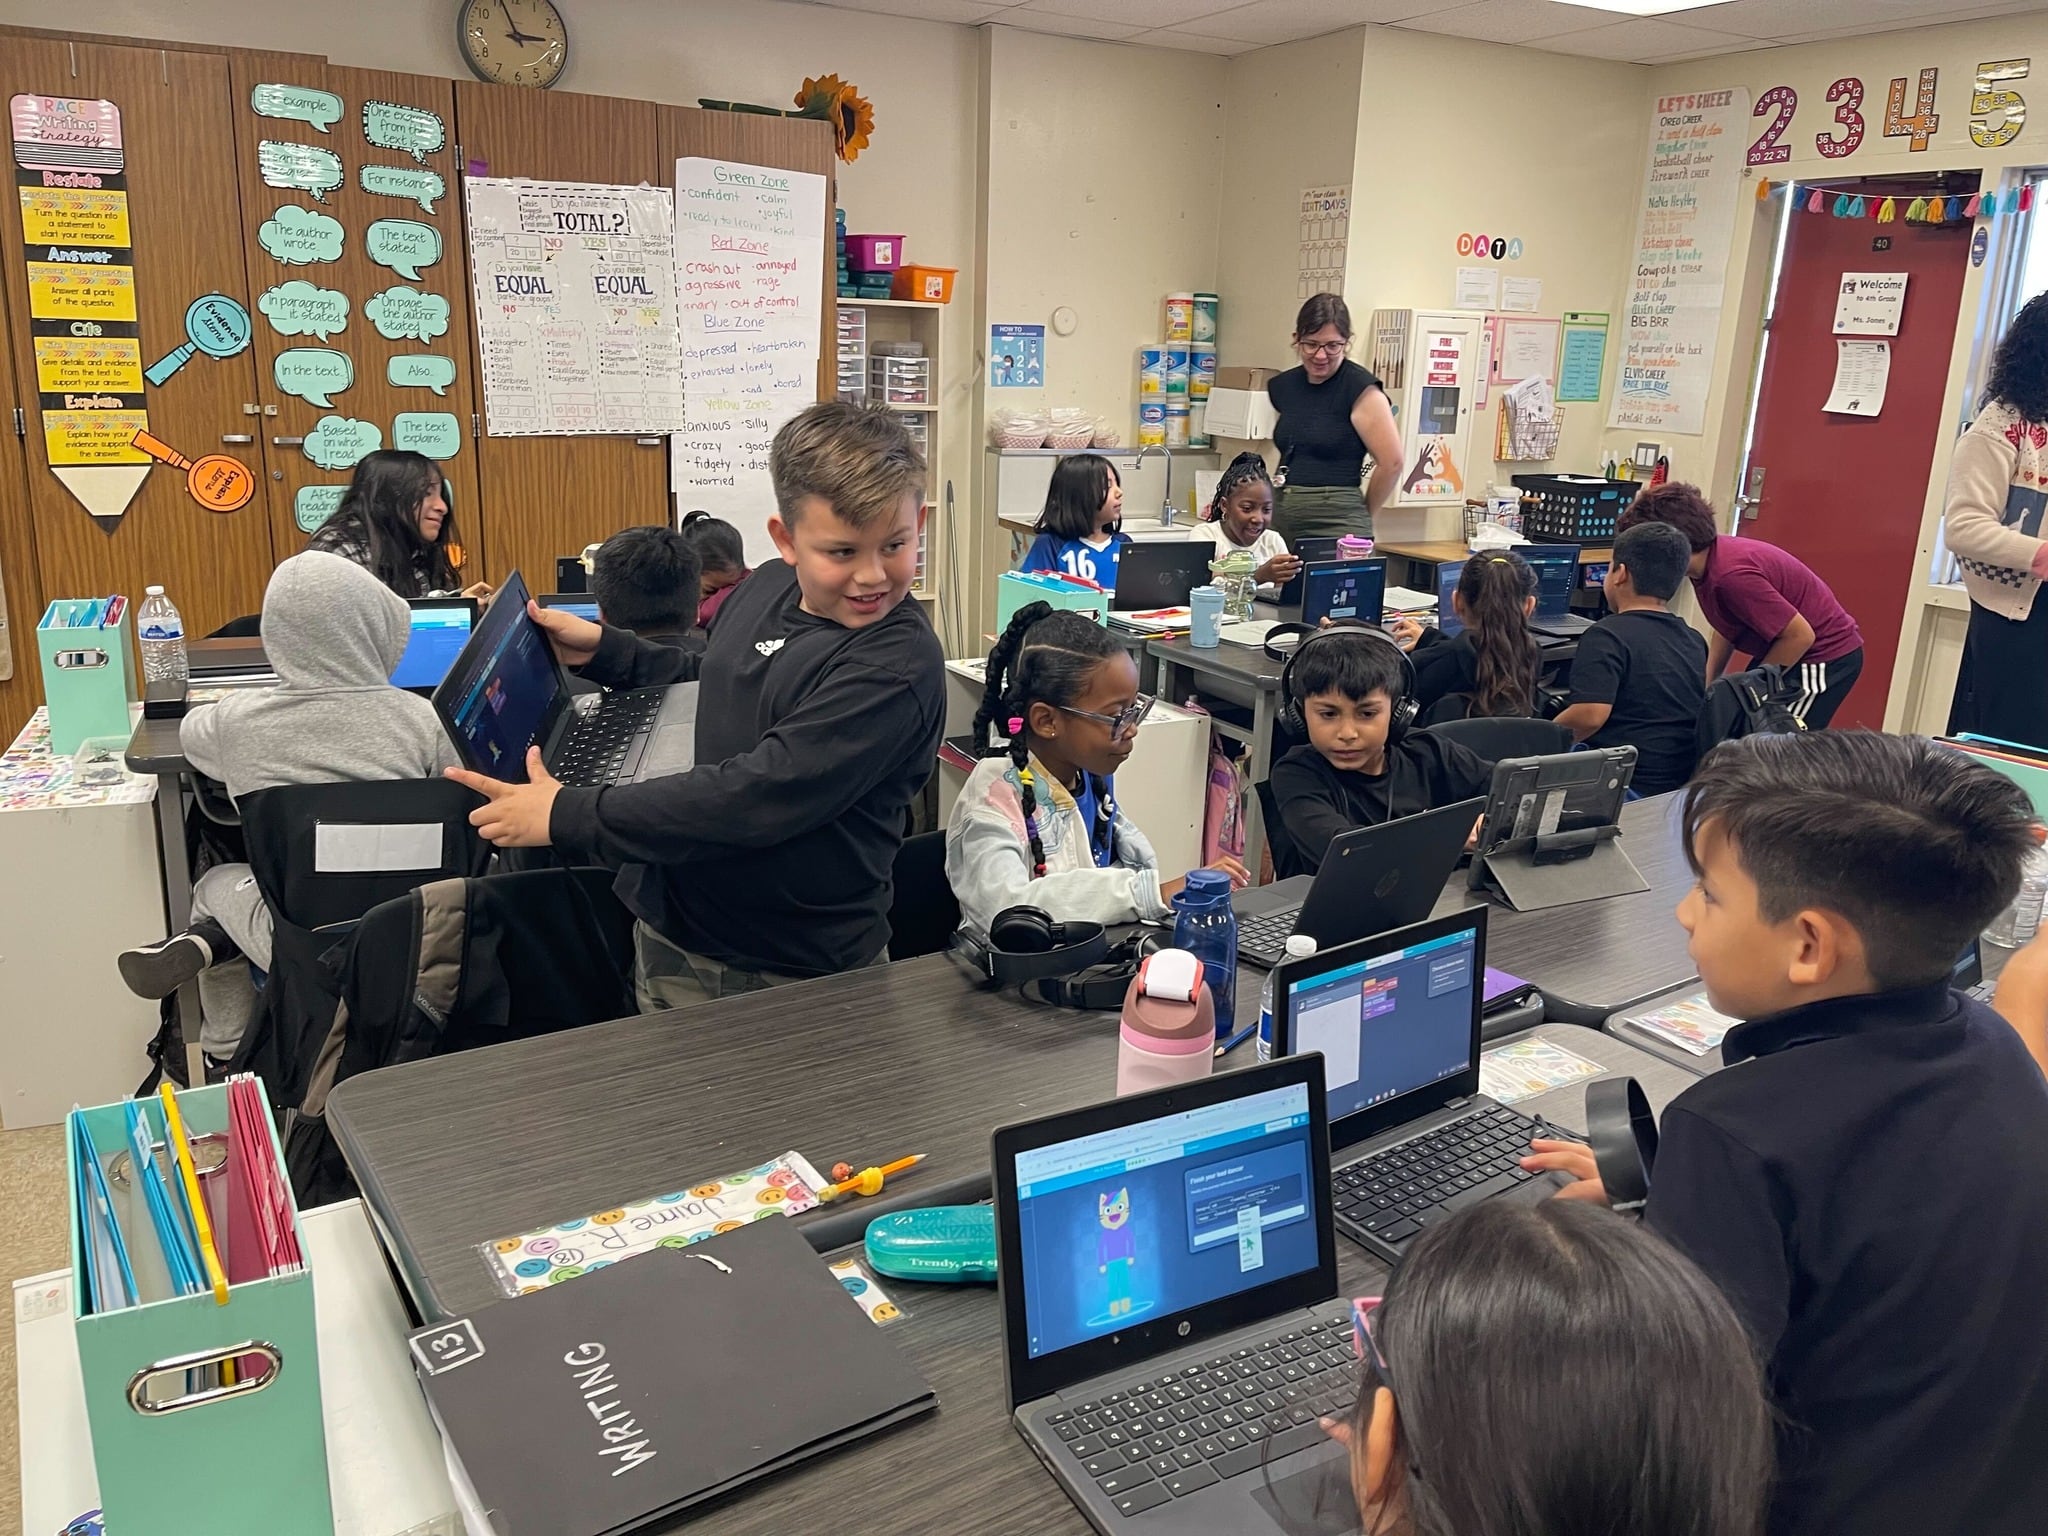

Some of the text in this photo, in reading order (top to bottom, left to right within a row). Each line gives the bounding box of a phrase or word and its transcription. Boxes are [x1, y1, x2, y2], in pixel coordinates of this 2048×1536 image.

[479, 8, 490, 20] 10
[546, 18, 552, 29] 2
[482, 47, 489, 58] 8
[496, 63, 502, 74] 7
[533, 68, 540, 79] 5
[1922, 70, 1935, 79] 48
[515, 71, 522, 82] 6
[1921, 82, 1933, 90] 44
[1696, 90, 1733, 109] CHEER
[1920, 94, 1932, 103] 40
[1969, 58, 2031, 147] 5
[1976, 94, 2006, 109] 30 35
[44, 98, 86, 115] RACE
[370, 105, 391, 118] One
[1883, 67, 1939, 152] 4
[1919, 106, 1930, 115] 36
[37, 114, 98, 133] Writing
[1660, 115, 1702, 126] OREO CHEER
[1816, 78, 1864, 158] 3
[1925, 118, 1936, 128] 32
[380, 120, 406, 134] from
[1747, 86, 1798, 166] 2
[31, 127, 105, 148] Strategy
[383, 131, 407, 146] text
[1982, 130, 2014, 144] 55 50
[1750, 152, 1774, 161] 20 22
[43, 171, 102, 189] Restate
[367, 172, 385, 185] For
[713, 165, 790, 189] Green Zone
[1302, 199, 1346, 213] BIRTHDAYS
[34, 209, 103, 222] Turn question
[57, 220, 95, 229] statement
[271, 222, 333, 240] The author
[40, 230, 78, 242] start your
[380, 227, 427, 244] The text
[544, 237, 606, 249] NO YES
[711, 234, 769, 252] Red Zone
[1460, 236, 1521, 257] DATA
[1876, 239, 1888, 249] 40
[47, 246, 113, 264] Answer
[495, 264, 542, 276] Do you have
[598, 265, 646, 276] Do you need
[724, 264, 742, 275] out
[494, 275, 553, 295] EQUAL
[594, 275, 653, 295] EQUAL
[757, 277, 781, 291] rage
[1860, 279, 1903, 290] Welcome
[51, 287, 115, 298] Answer parts
[497, 294, 517, 303] parts
[600, 295, 619, 303] parts
[65, 298, 78, 306] the
[268, 294, 336, 314] In paragraph
[382, 295, 423, 313] On page
[754, 296, 799, 309] of control
[382, 307, 436, 322] the author
[502, 305, 516, 314] NO
[613, 309, 660, 318] NO YES
[205, 302, 242, 343] Evidence
[704, 314, 766, 328] Blue Zone
[1631, 316, 1669, 327] BIG BRR
[70, 322, 103, 337] Cite
[201, 318, 225, 344] Stems
[685, 342, 738, 360] depressed
[752, 340, 806, 354] heartbroken
[60, 359, 137, 368] details and evidence
[745, 361, 774, 375] lonely
[1016, 355, 1025, 368] 2
[282, 365, 312, 377] In the
[690, 365, 735, 380] exhausted
[1016, 370, 1024, 383] 3
[1624, 368, 1666, 379] ELVIS CHEER
[52, 379, 81, 388] support
[64, 393, 124, 411] Explain
[704, 399, 739, 410] Yellow
[322, 424, 357, 438] Based
[402, 421, 448, 433] The text
[687, 420, 731, 431] anxious
[66, 430, 128, 443] Explain how your
[323, 438, 336, 447] on
[65, 440, 98, 449] evidence
[690, 441, 722, 452] crazy
[694, 456, 731, 472] fidgety
[213, 469, 241, 501] Explain
[695, 476, 734, 486] worried
[301, 511, 325, 523] text
[1060, 548, 1097, 581] 16
[630, 1197, 726, 1231] Jaime
[554, 1250, 577, 1266] 18
[908, 1257, 960, 1269] Trendy,
[431, 1332, 467, 1361] 13
[563, 1342, 658, 1477] WRITING
